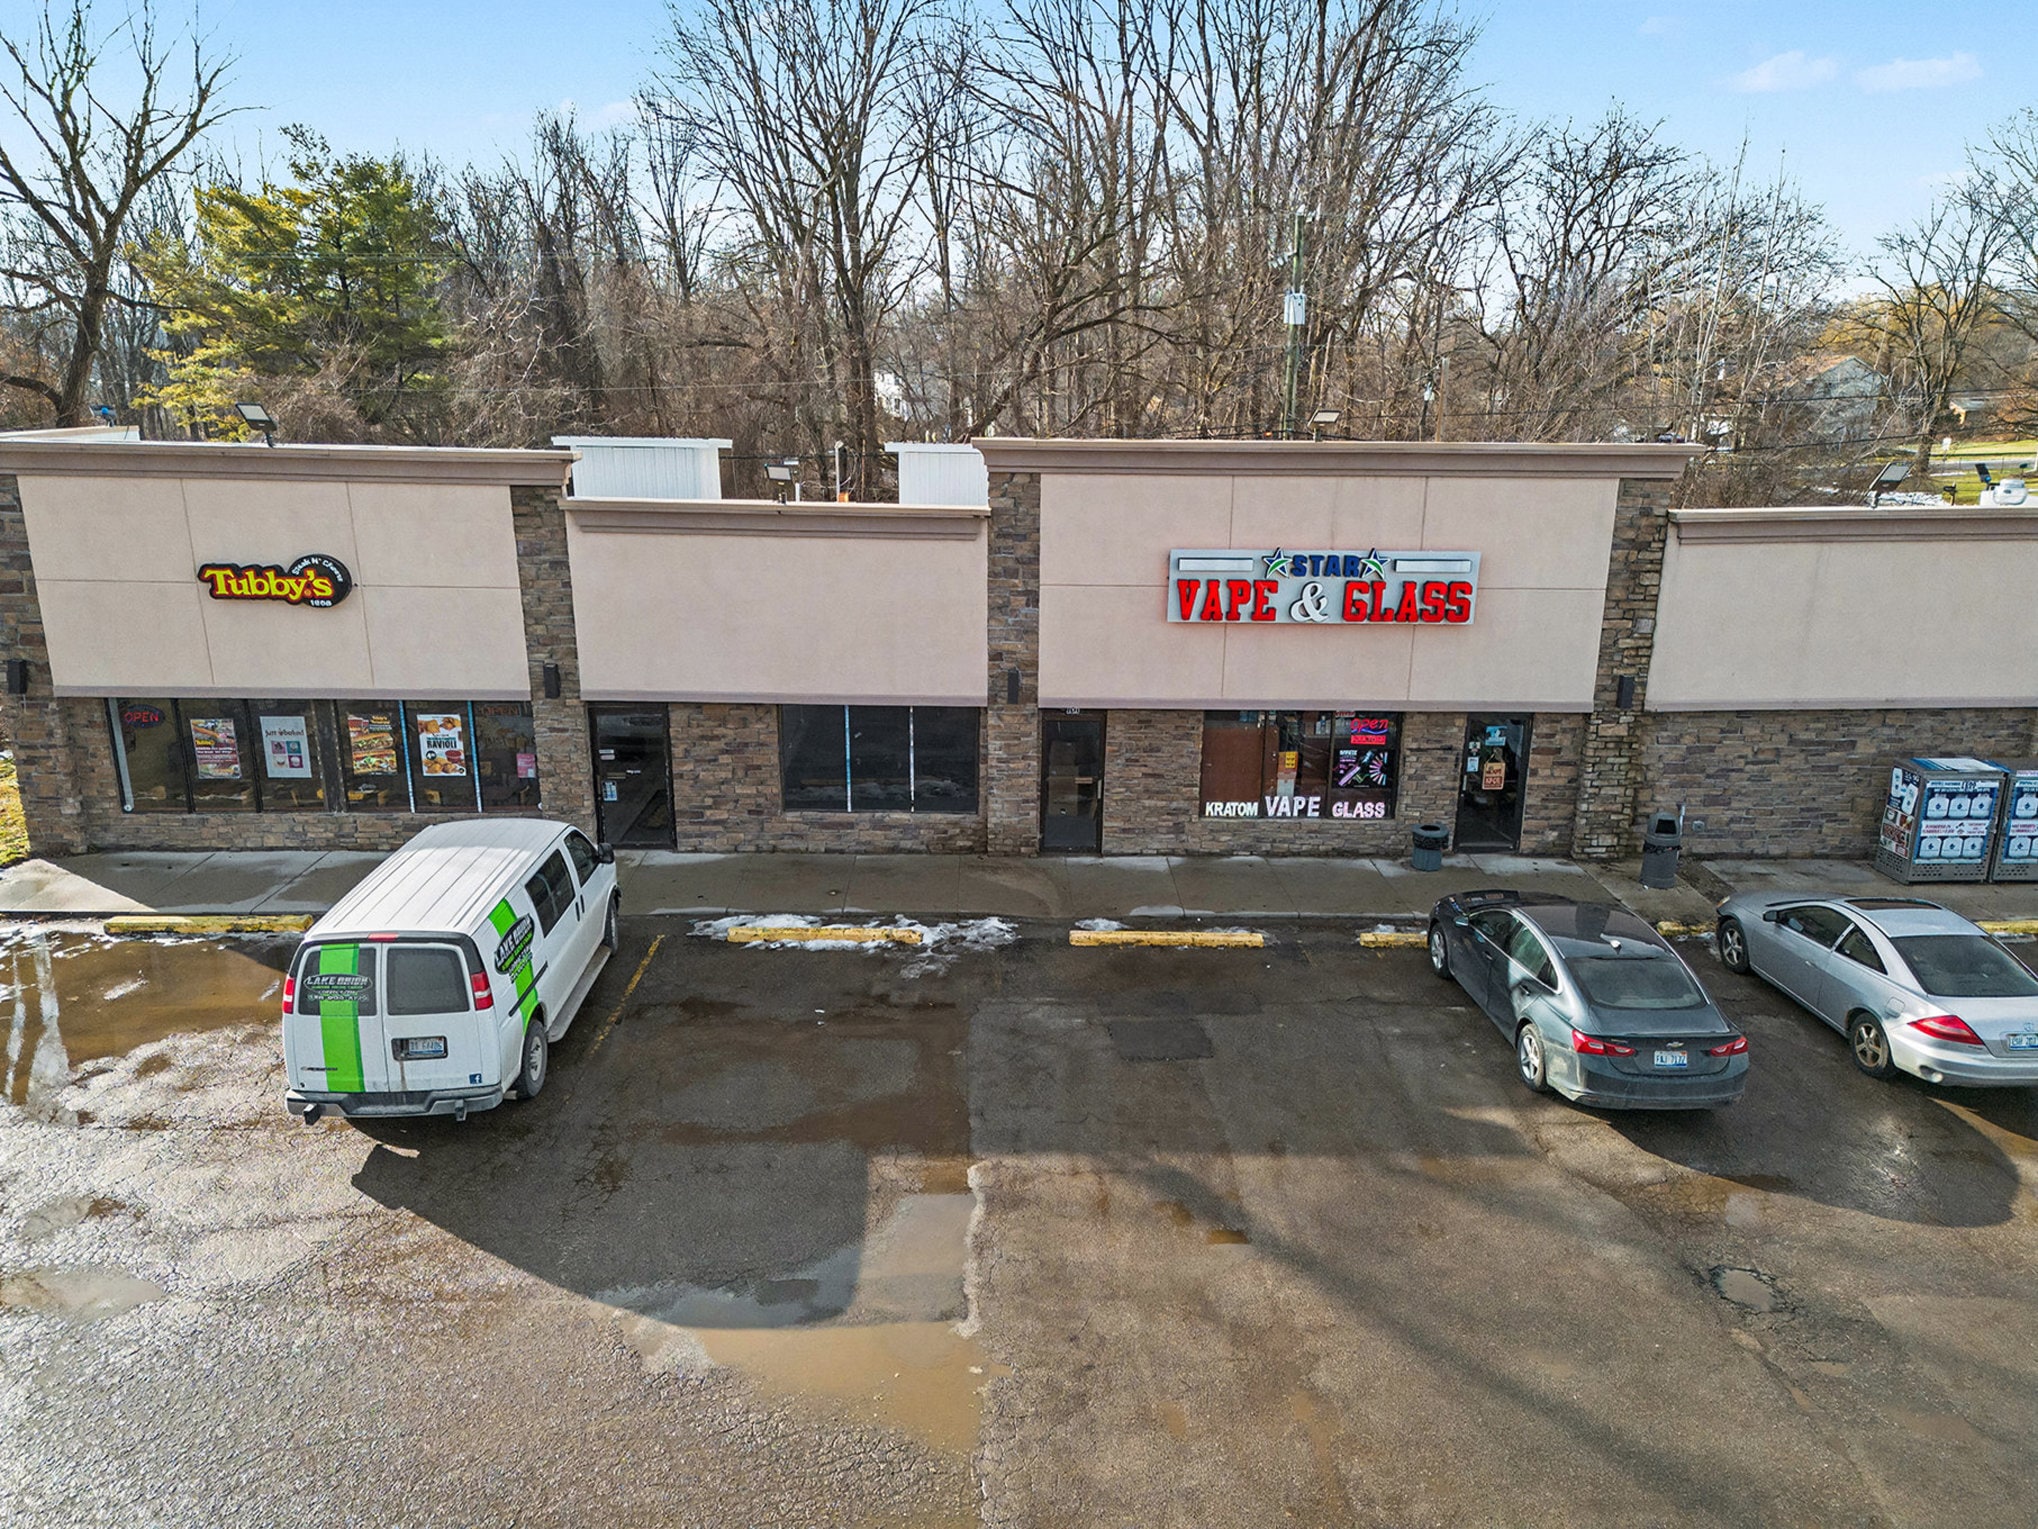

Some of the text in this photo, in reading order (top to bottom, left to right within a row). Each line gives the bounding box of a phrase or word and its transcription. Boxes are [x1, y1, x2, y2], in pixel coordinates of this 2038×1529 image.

[1290, 554, 1361, 578] STAR
[203, 568, 334, 601] Tubby's
[1177, 579, 1473, 623] VAPE & GLASS
[124, 711, 159, 722] OPEN
[1205, 796, 1385, 818] KRATOM VAPE GLASS
[307, 976, 336, 985] LAKE
